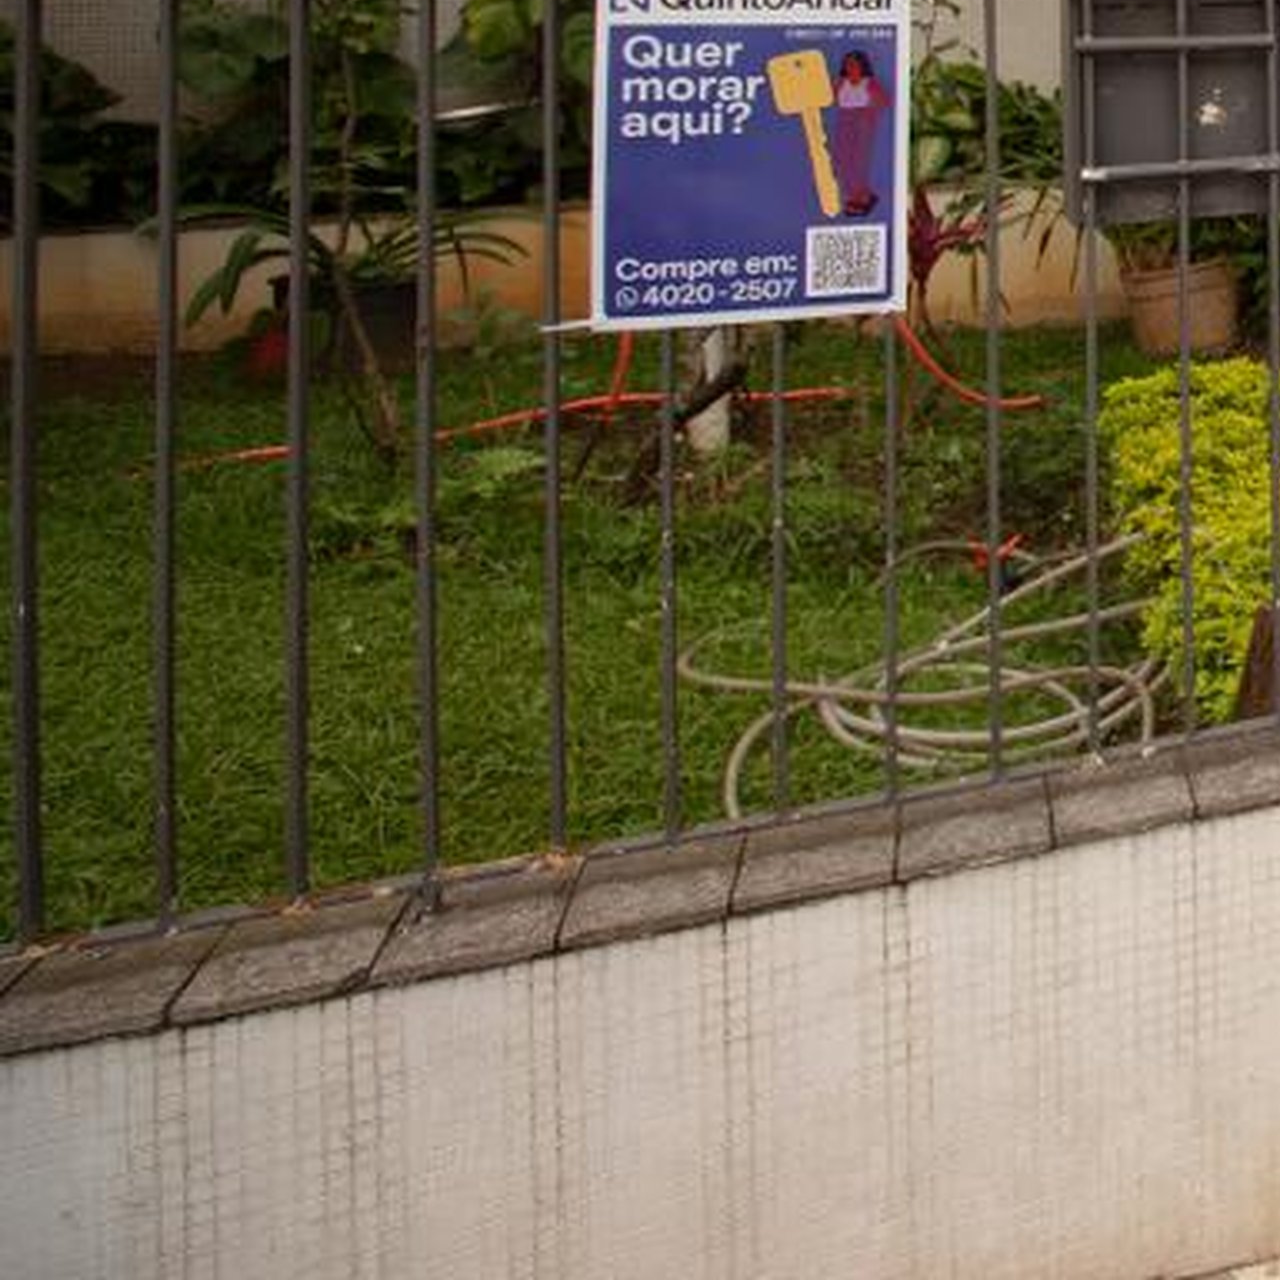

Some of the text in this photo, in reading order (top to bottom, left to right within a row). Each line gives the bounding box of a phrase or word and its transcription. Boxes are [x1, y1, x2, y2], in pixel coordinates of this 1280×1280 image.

[622, 33, 744, 69] Quer
[621, 74, 766, 102] morar
[620, 101, 752, 145] aqui?
[615, 254, 798, 282] Compre em:
